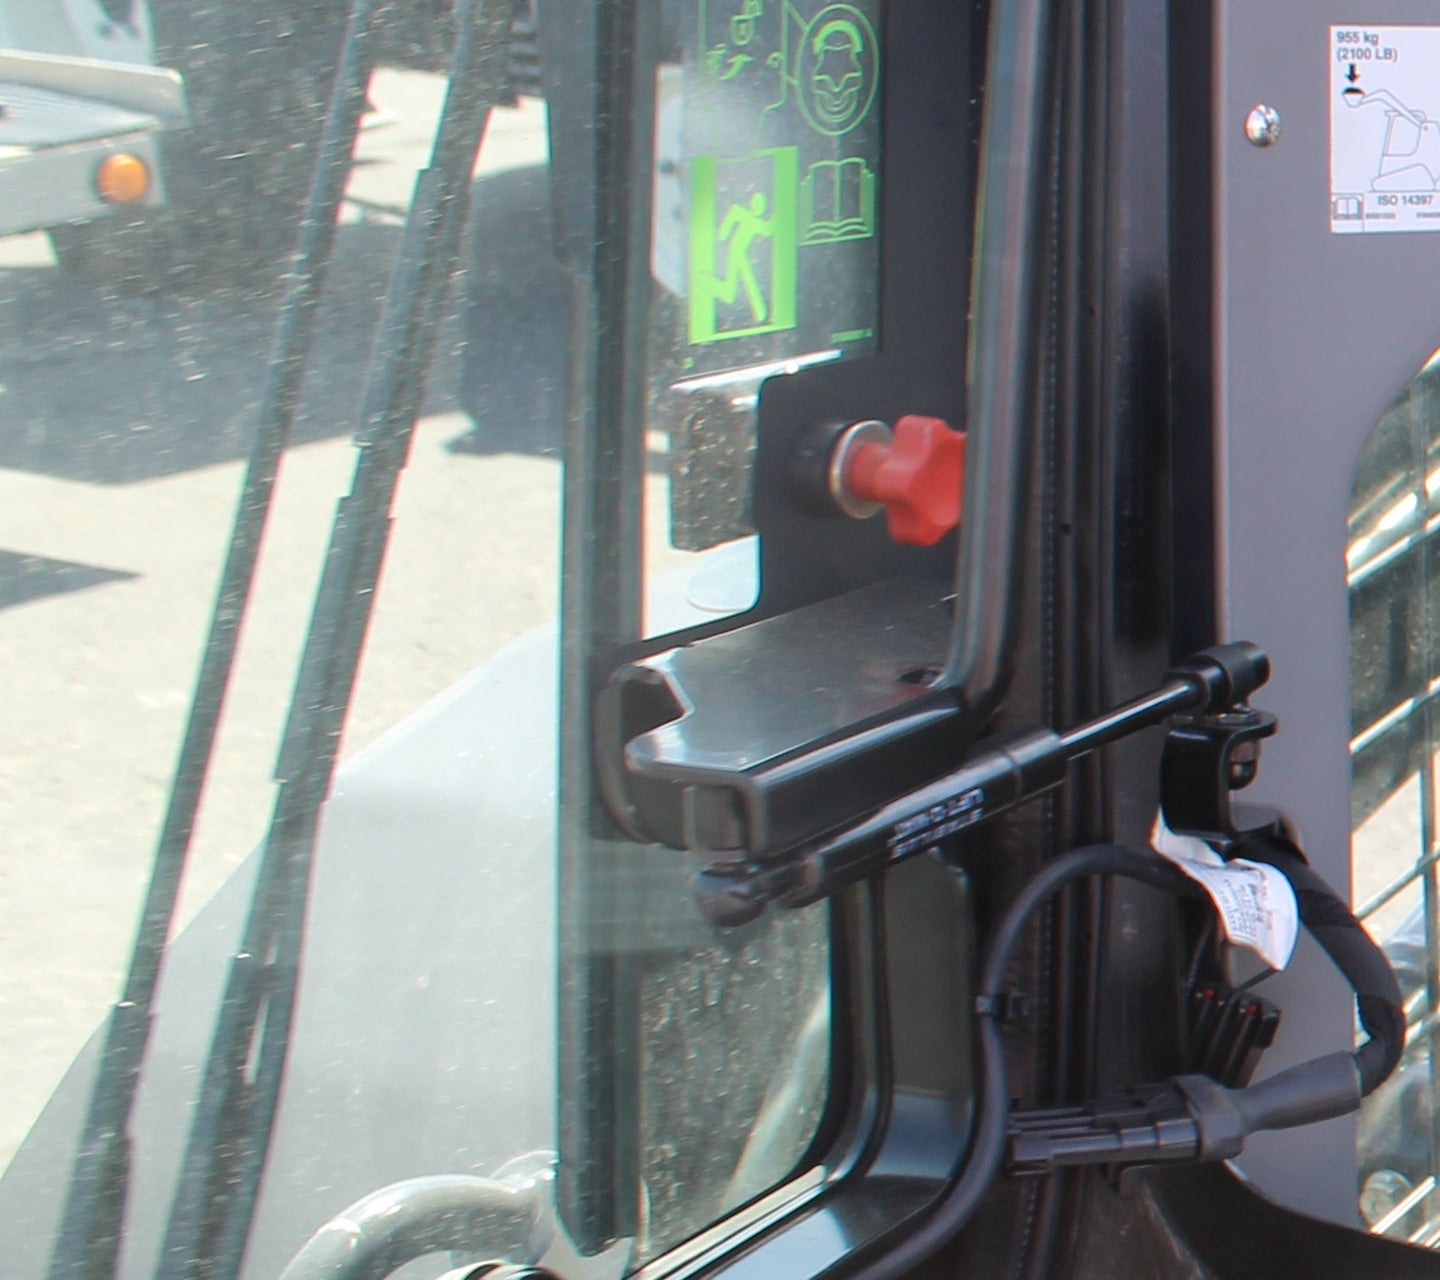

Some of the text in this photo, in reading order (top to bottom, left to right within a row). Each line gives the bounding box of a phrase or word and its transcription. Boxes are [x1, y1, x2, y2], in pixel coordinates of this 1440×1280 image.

[1336, 31, 1380, 46] 955 kg
[1336, 48, 1399, 62] (2100 LB)
[1377, 194, 1434, 206] ISO 14397
